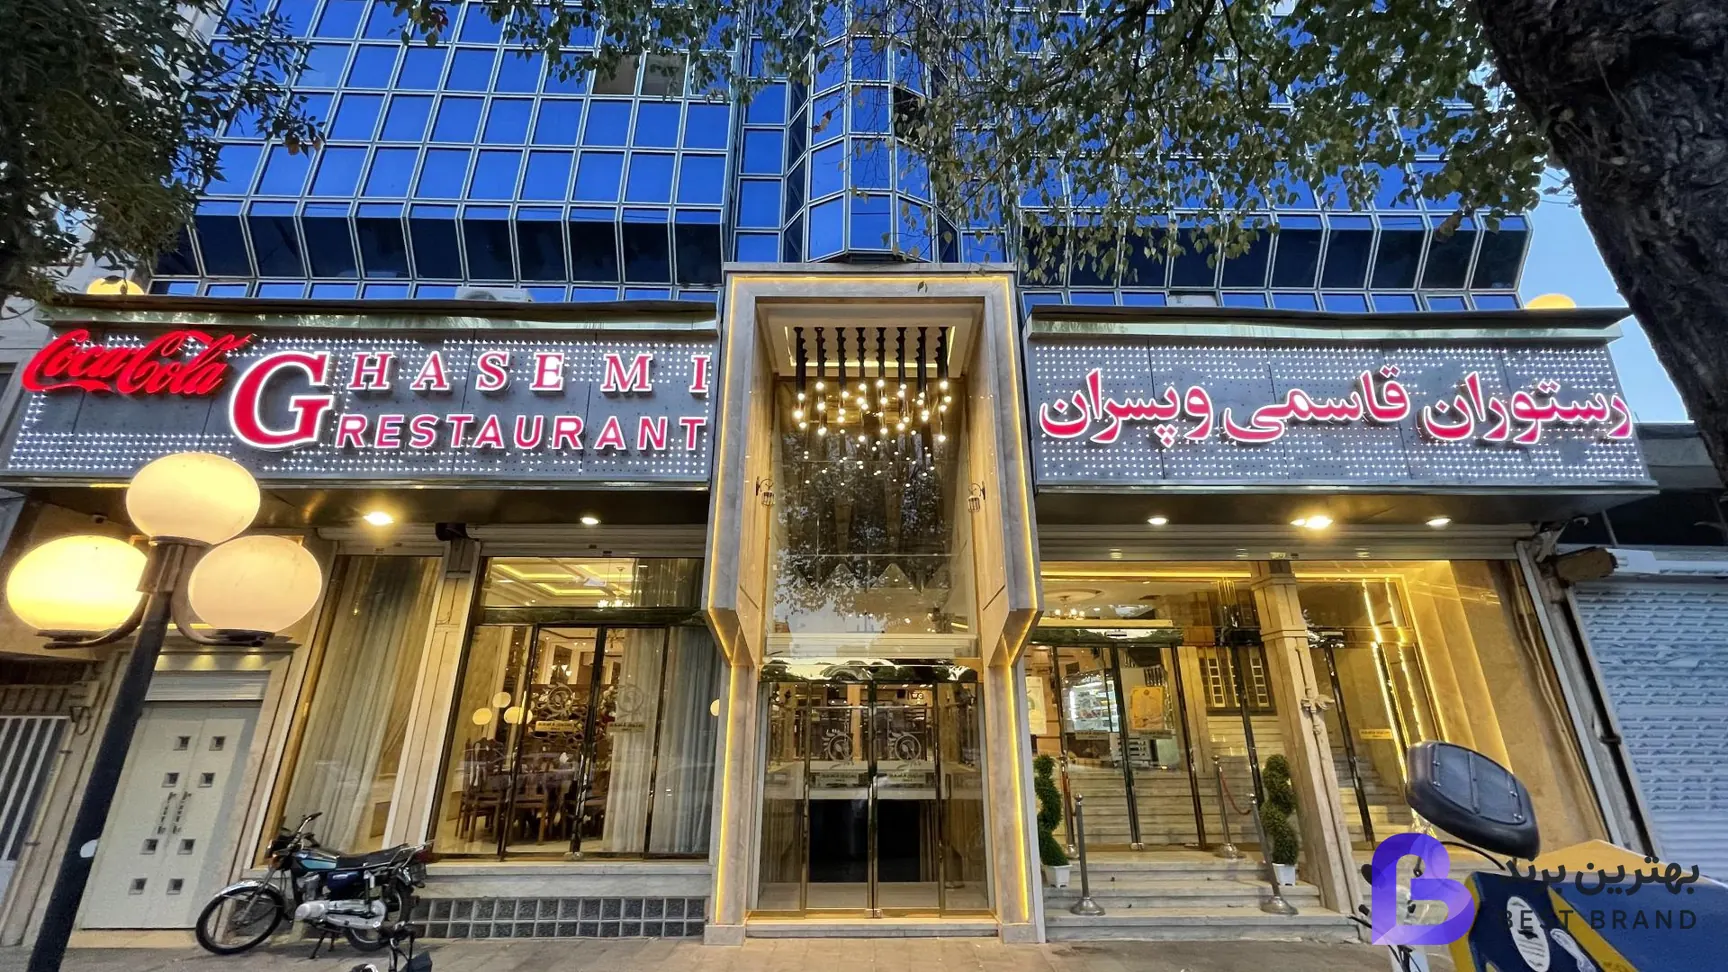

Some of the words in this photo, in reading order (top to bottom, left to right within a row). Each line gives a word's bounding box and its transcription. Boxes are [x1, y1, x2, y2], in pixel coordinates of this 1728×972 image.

[229, 351, 709, 449] GHASEMI
[334, 413, 707, 451] RESTAURANT
[1223, 364, 1410, 443] قاسمی
[1423, 371, 1632, 444] رستوران
